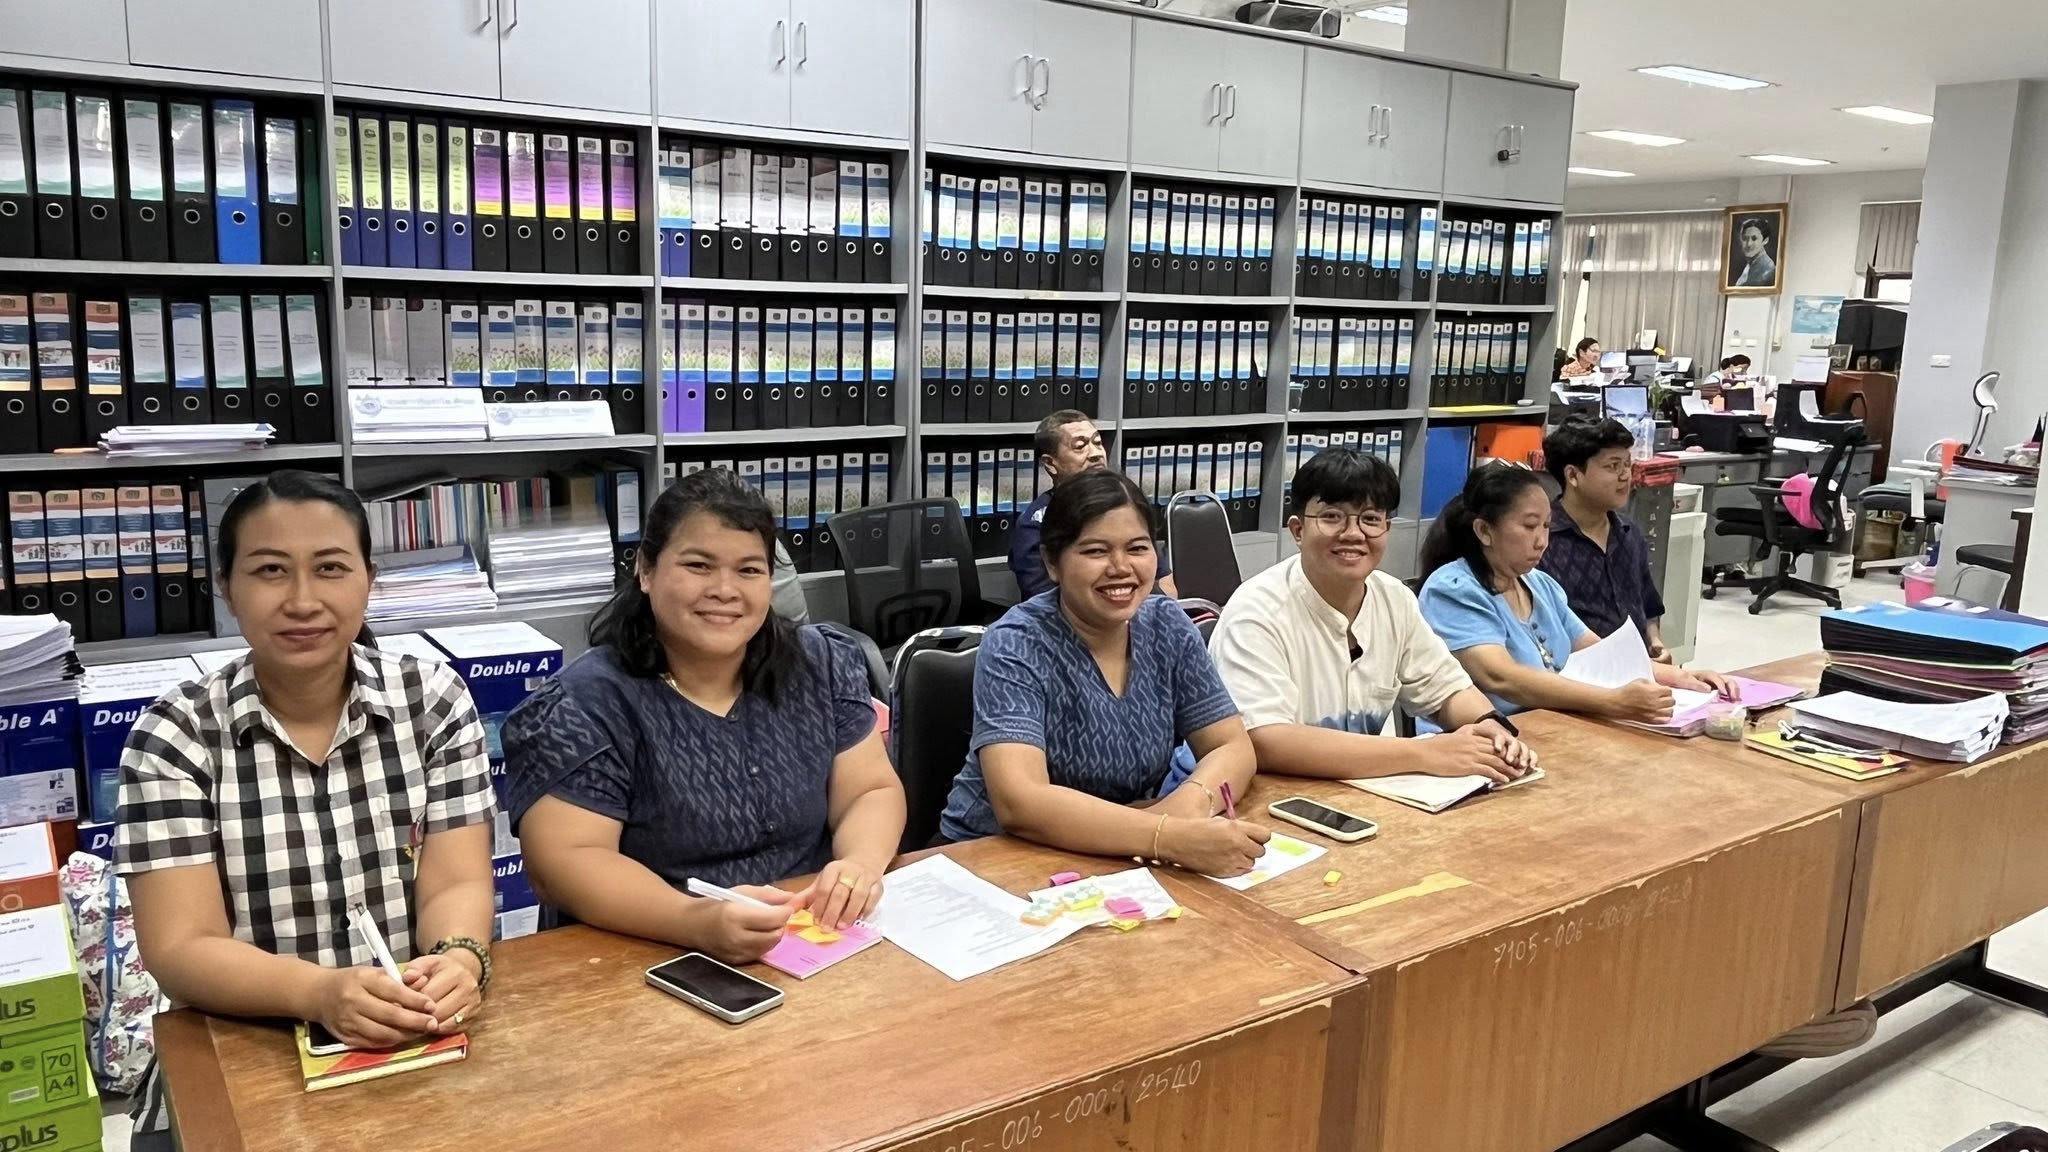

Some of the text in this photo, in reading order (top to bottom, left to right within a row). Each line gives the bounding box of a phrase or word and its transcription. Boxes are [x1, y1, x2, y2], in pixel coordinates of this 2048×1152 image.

[469, 657, 549, 678] Double A
[40, 709, 57, 726] A
[493, 860, 523, 877] ubl
[46, 1052, 72, 1071] 70
[47, 1075, 74, 1094] A4
